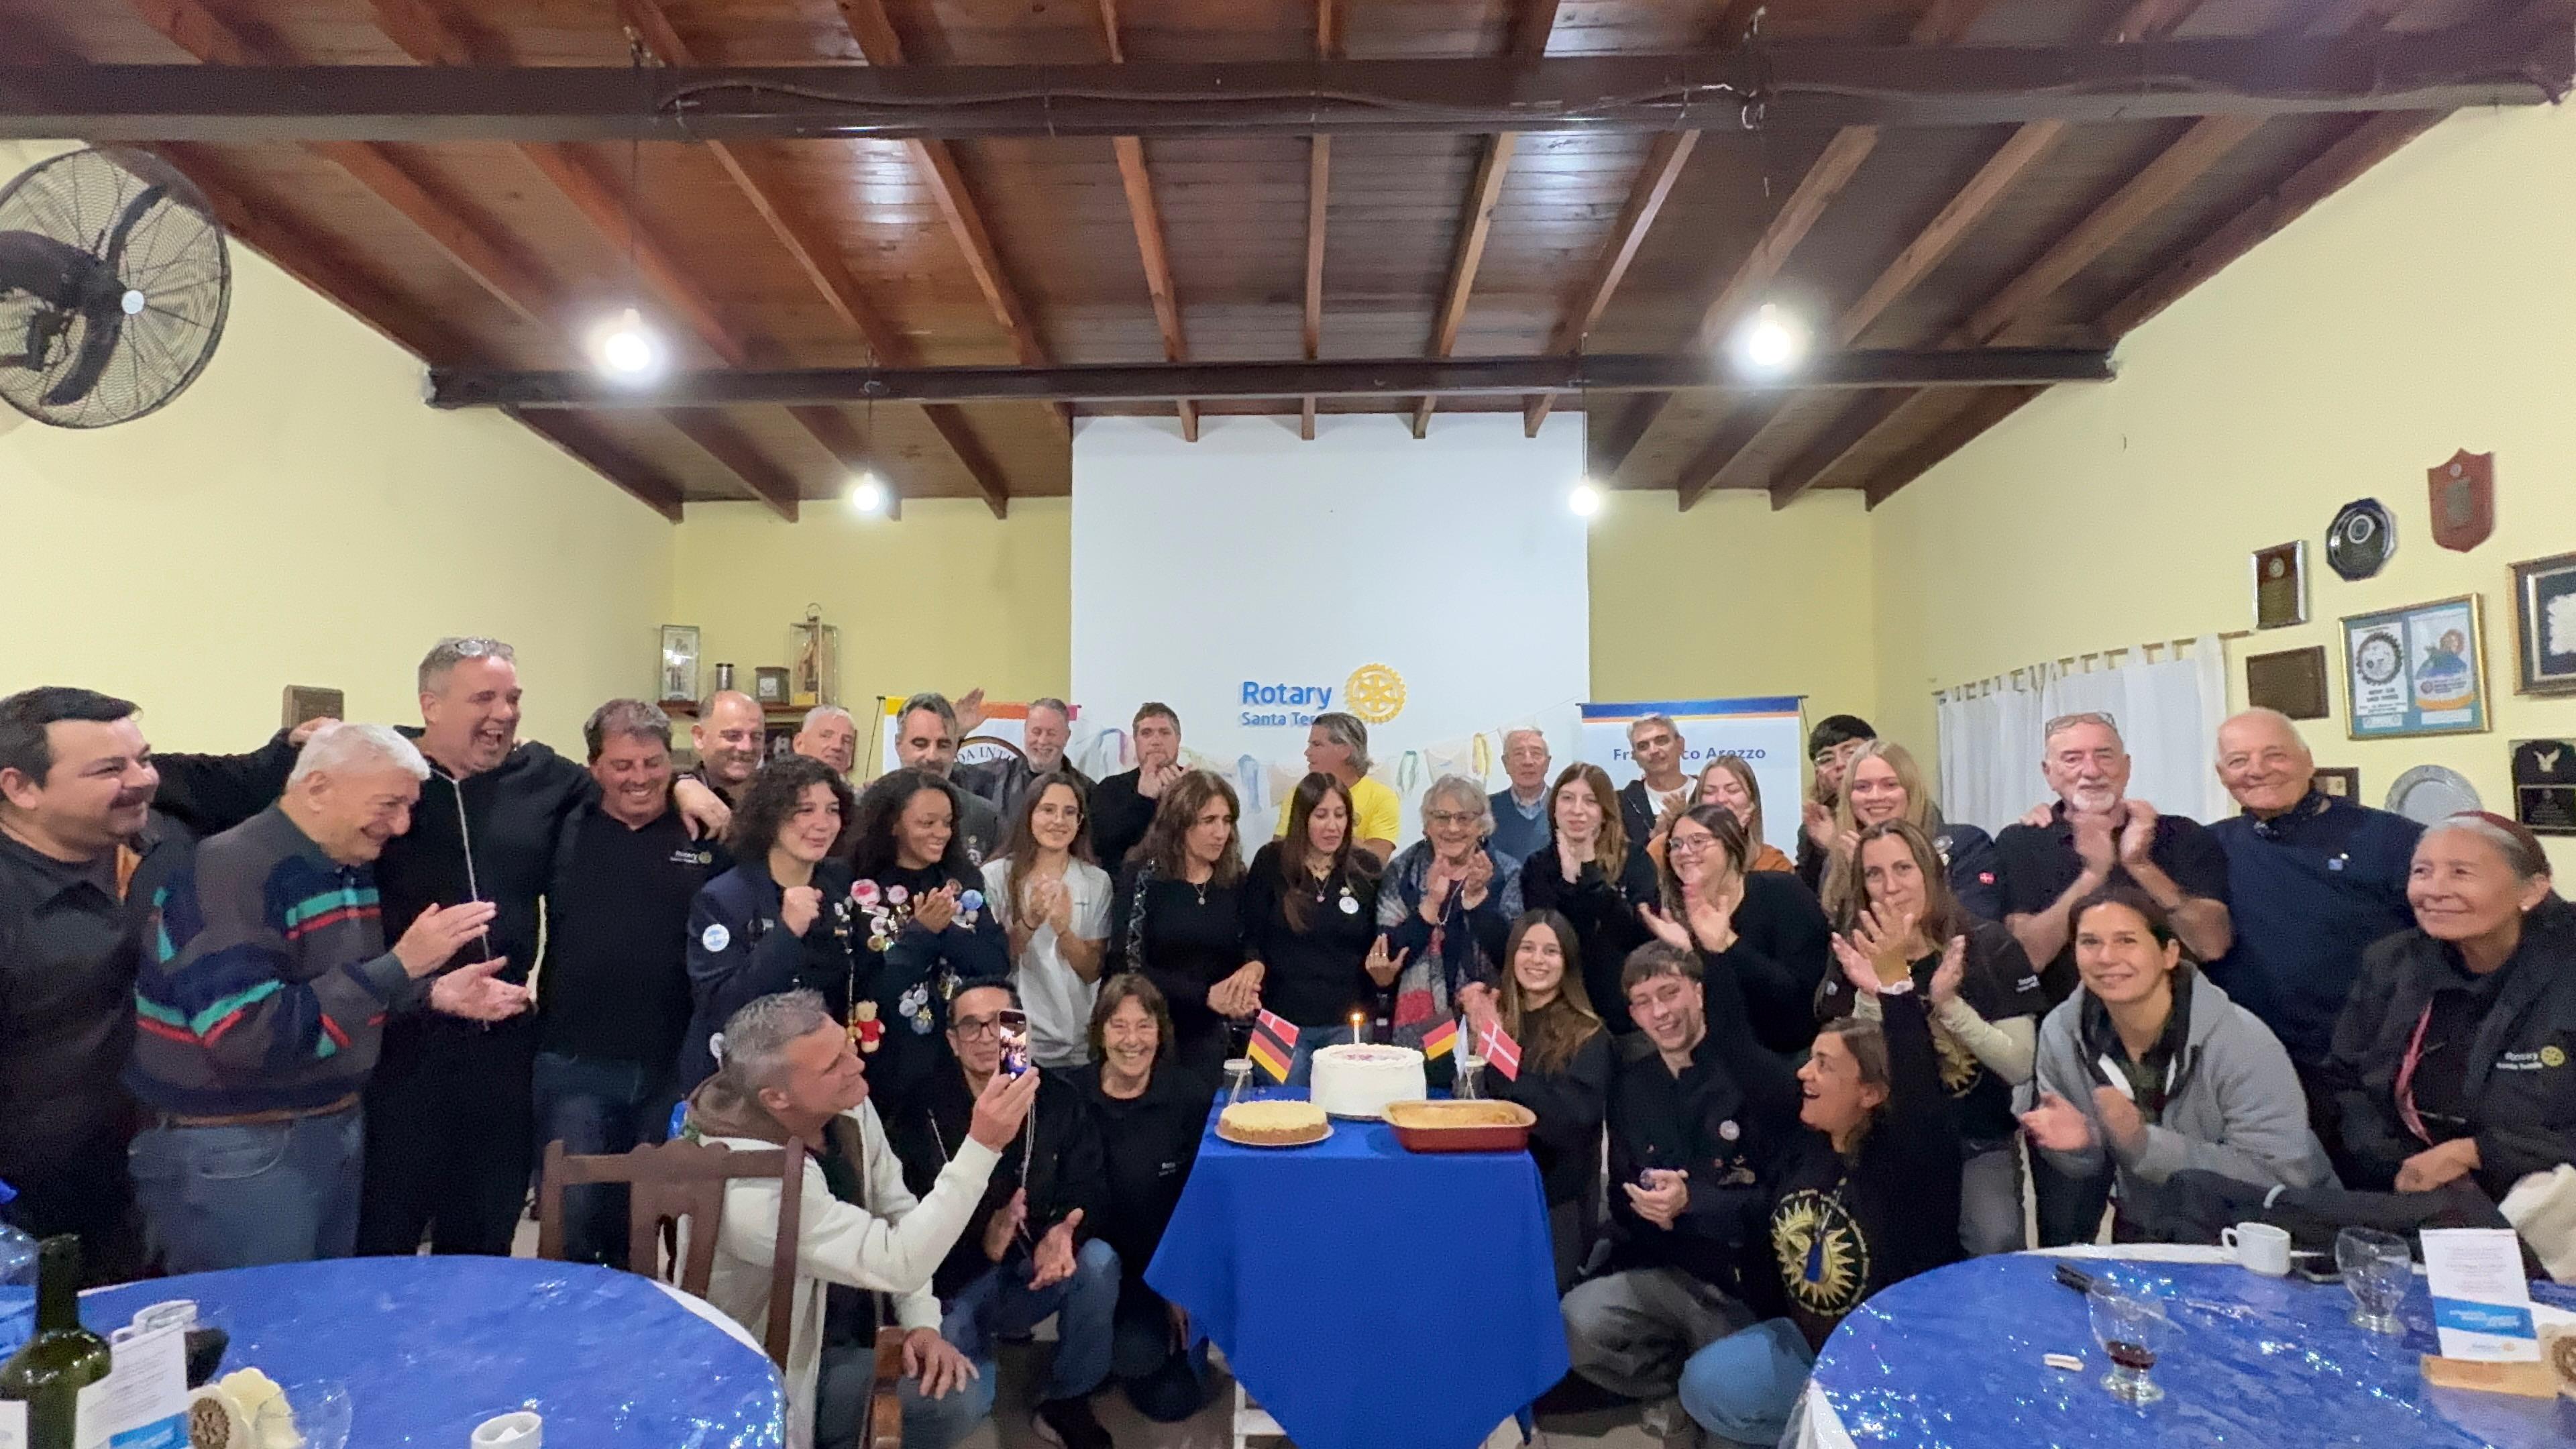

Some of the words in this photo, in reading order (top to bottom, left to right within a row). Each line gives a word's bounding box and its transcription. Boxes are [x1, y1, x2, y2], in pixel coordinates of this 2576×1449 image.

[1242, 681, 1332, 709] Rotary
[1241, 712, 1287, 726] Santa
[1291, 712, 1316, 726] Ter
